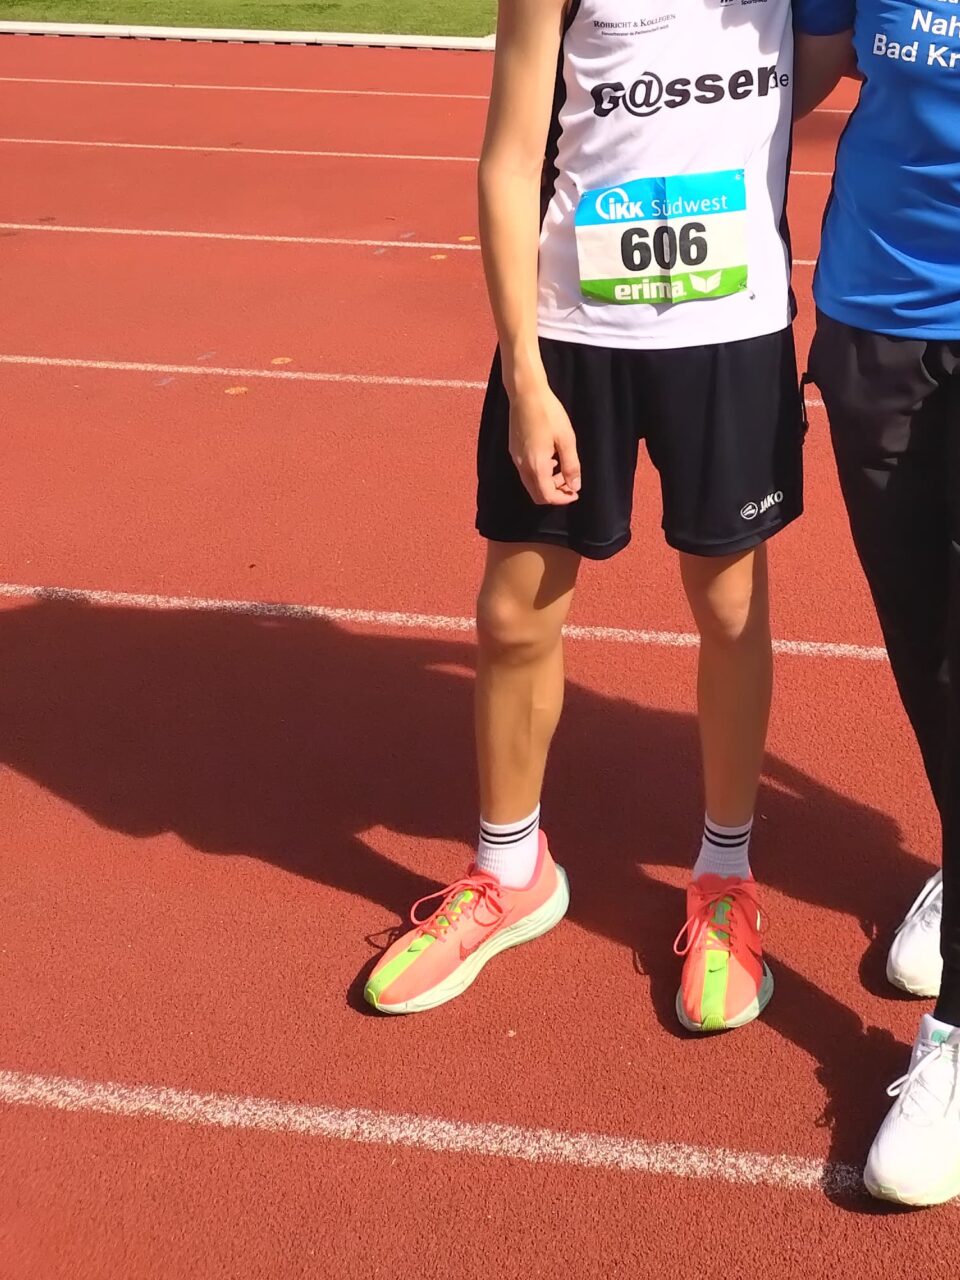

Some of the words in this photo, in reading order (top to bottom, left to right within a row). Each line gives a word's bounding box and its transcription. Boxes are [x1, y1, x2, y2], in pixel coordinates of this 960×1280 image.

[872, 33, 919, 63] Bad
[651, 195, 728, 216] Südwest
[620, 222, 708, 271] 606
[614, 279, 685, 301] erima
[759, 490, 784, 513] JAKO
